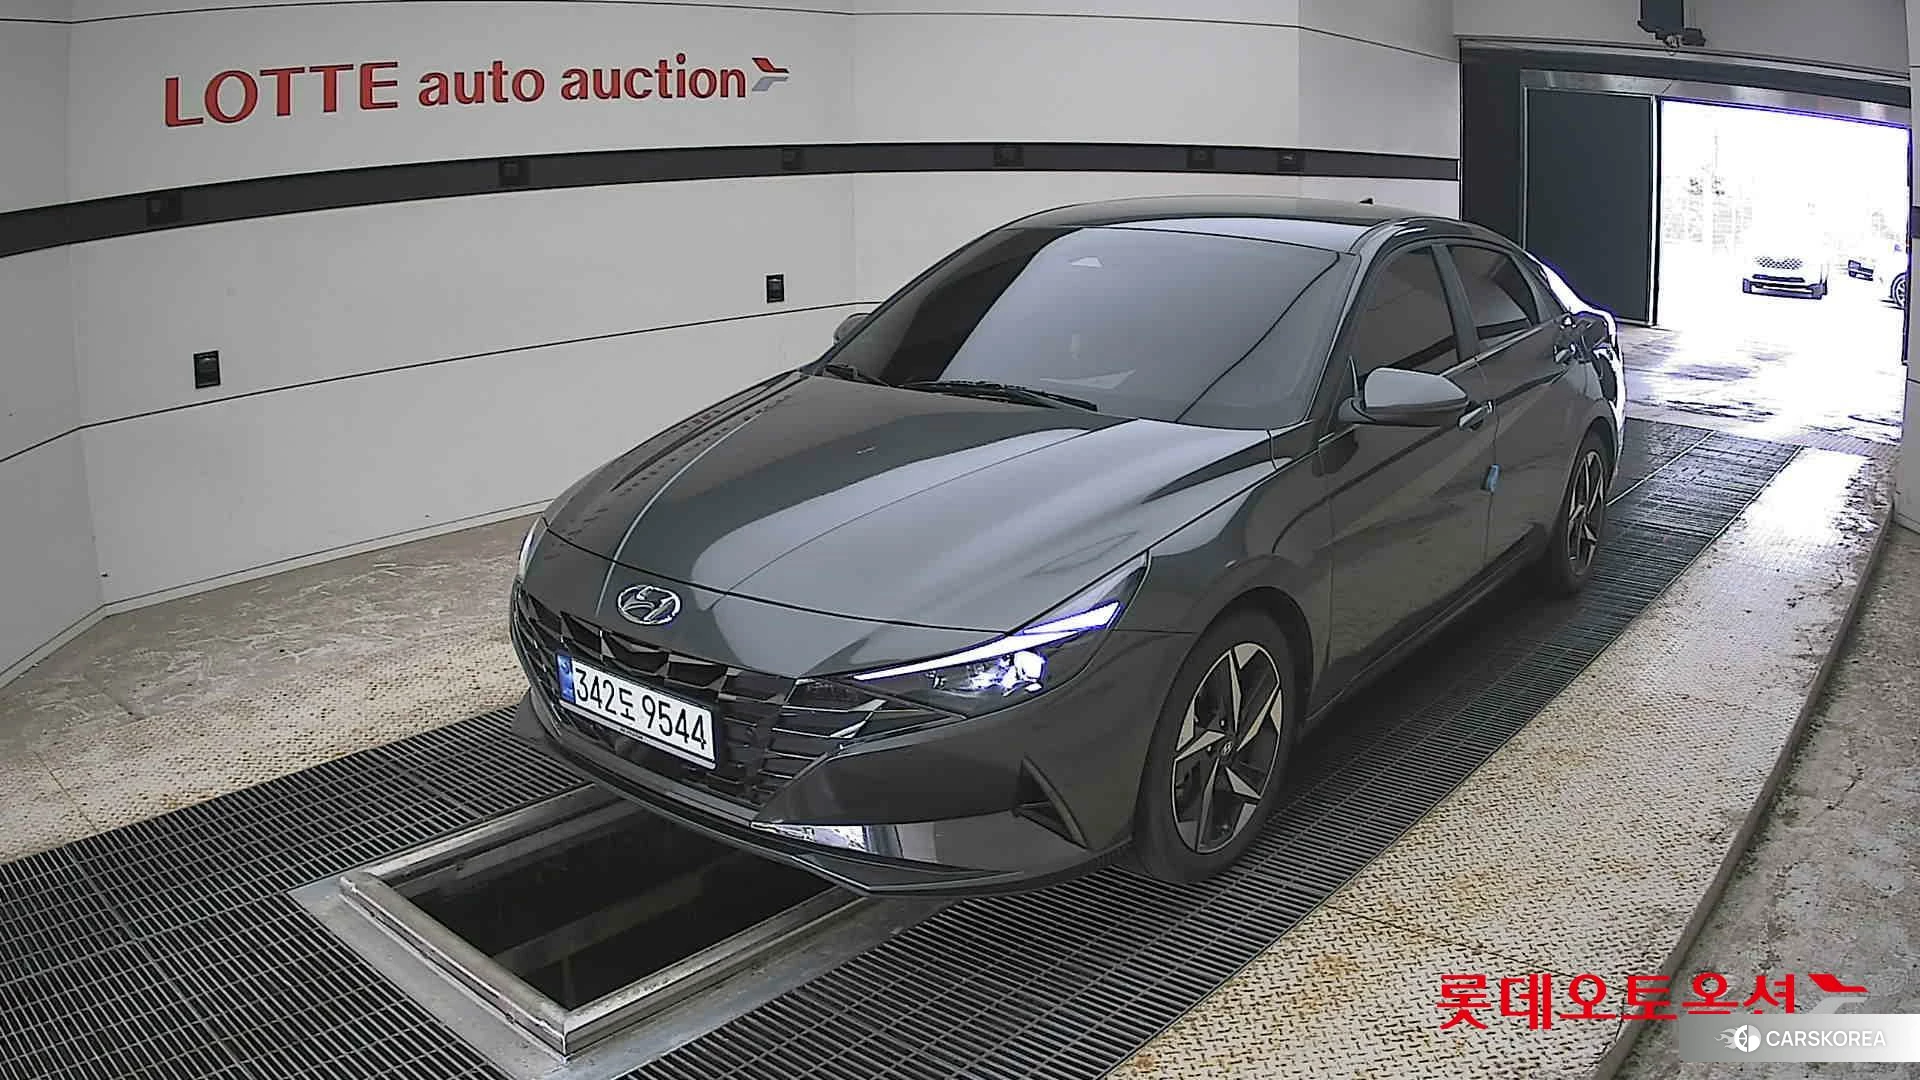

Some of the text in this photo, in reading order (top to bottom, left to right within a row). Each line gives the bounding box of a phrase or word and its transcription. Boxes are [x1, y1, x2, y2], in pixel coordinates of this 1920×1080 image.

[165, 52, 747, 127] LOTTE auto auction
[575, 667, 707, 750] 342도 9544
